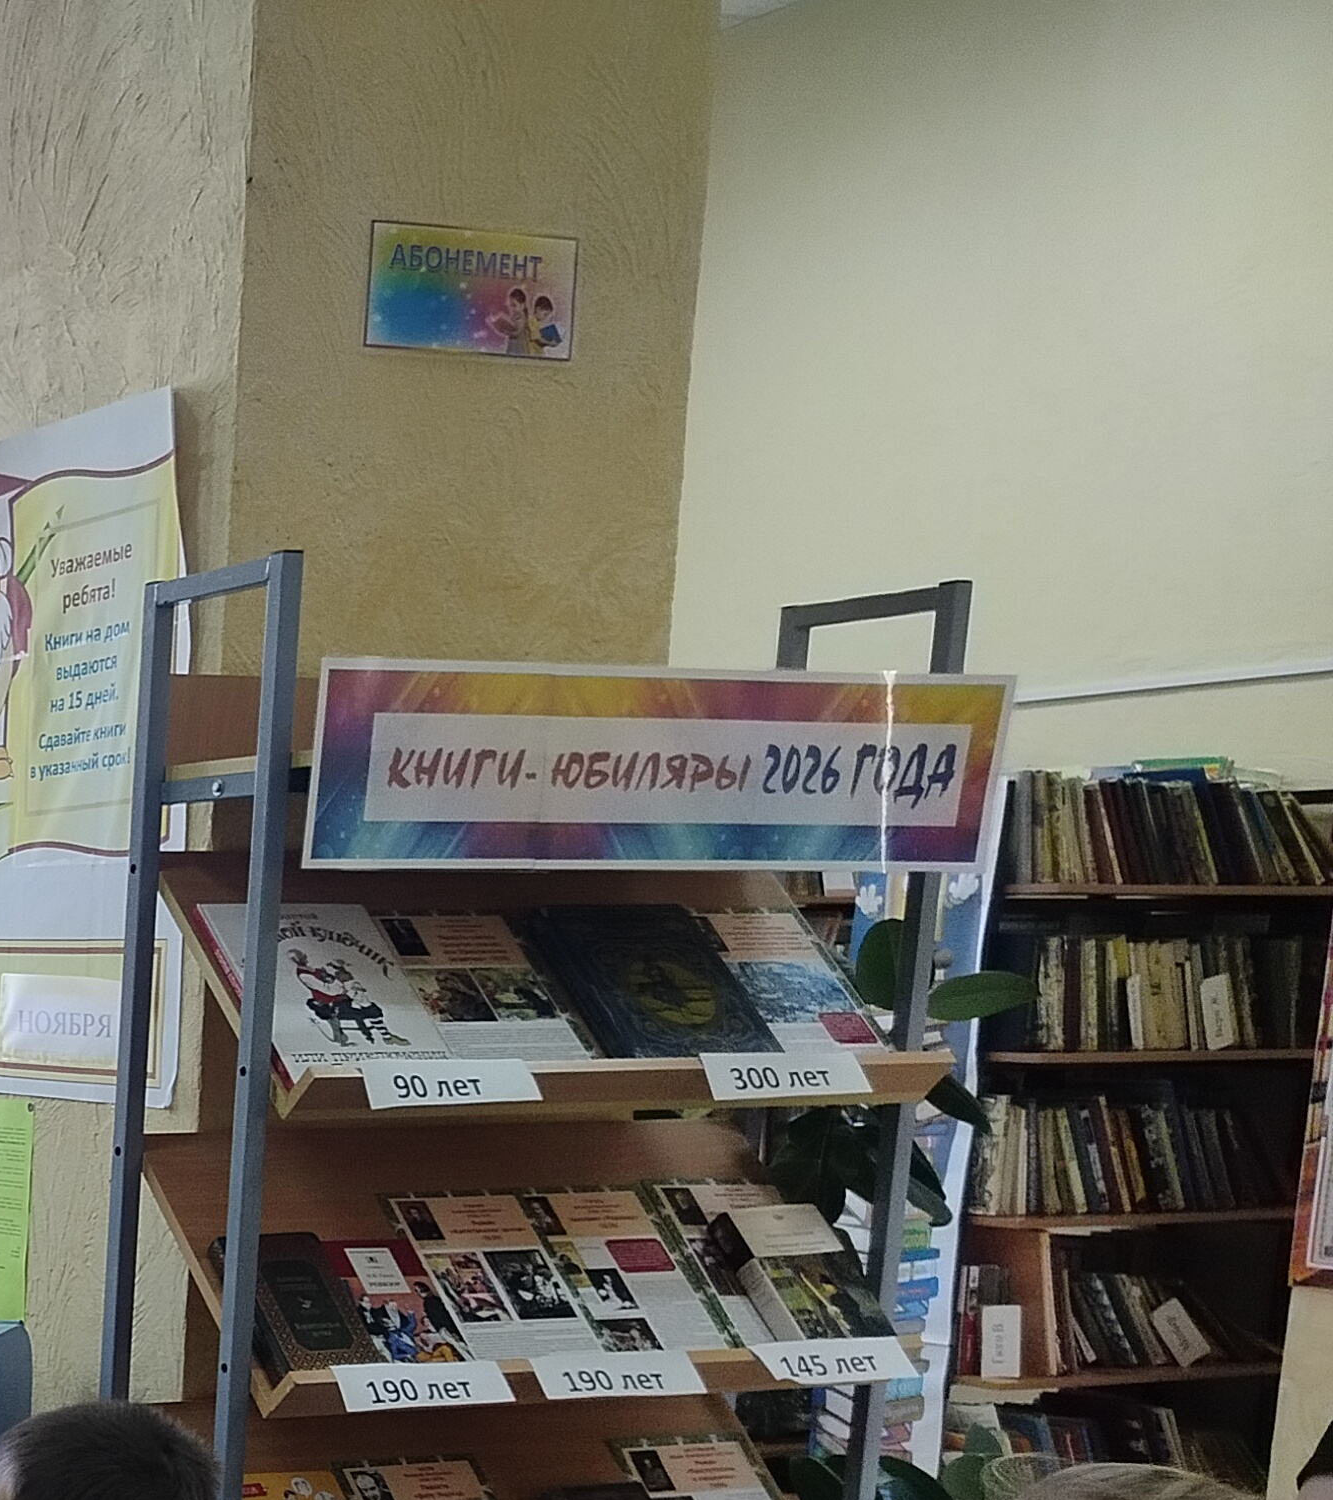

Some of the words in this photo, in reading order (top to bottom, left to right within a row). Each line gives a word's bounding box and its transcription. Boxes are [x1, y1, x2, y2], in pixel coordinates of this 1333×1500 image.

[390, 243, 542, 280] АБОНЕМЕНТ
[50, 543, 132, 578] Уважаемые
[63, 578, 117, 614] ребята!
[44, 630, 83, 652] Книги
[86, 628, 101, 642] на
[104, 619, 130, 643] дом
[56, 655, 118, 682] выдаются
[50, 697, 65, 713] на
[68, 690, 83, 710] 15
[85, 683, 119, 710] дней.
[38, 727, 92, 752] Сдавайте
[93, 723, 127, 741] книги
[30, 764, 37, 779] в
[39, 753, 99, 781] указанный
[102, 747, 130, 772] срок!
[550, 749, 752, 796] ЮБИЛЯРЫ
[760, 742, 841, 797] 2026
[848, 742, 957, 809] ГОДА
[17, 1009, 113, 1038] НОЯБРЯ
[393, 1073, 428, 1100] 90
[437, 1075, 482, 1098] лет
[729, 1066, 780, 1091] 300
[788, 1067, 830, 1089] лет
[779, 1355, 827, 1378] 145
[835, 1354, 880, 1375] лет
[365, 1379, 418, 1404] 190
[427, 1380, 473, 1401] лет
[562, 1370, 613, 1393] 190
[620, 1370, 665, 1391] лет
